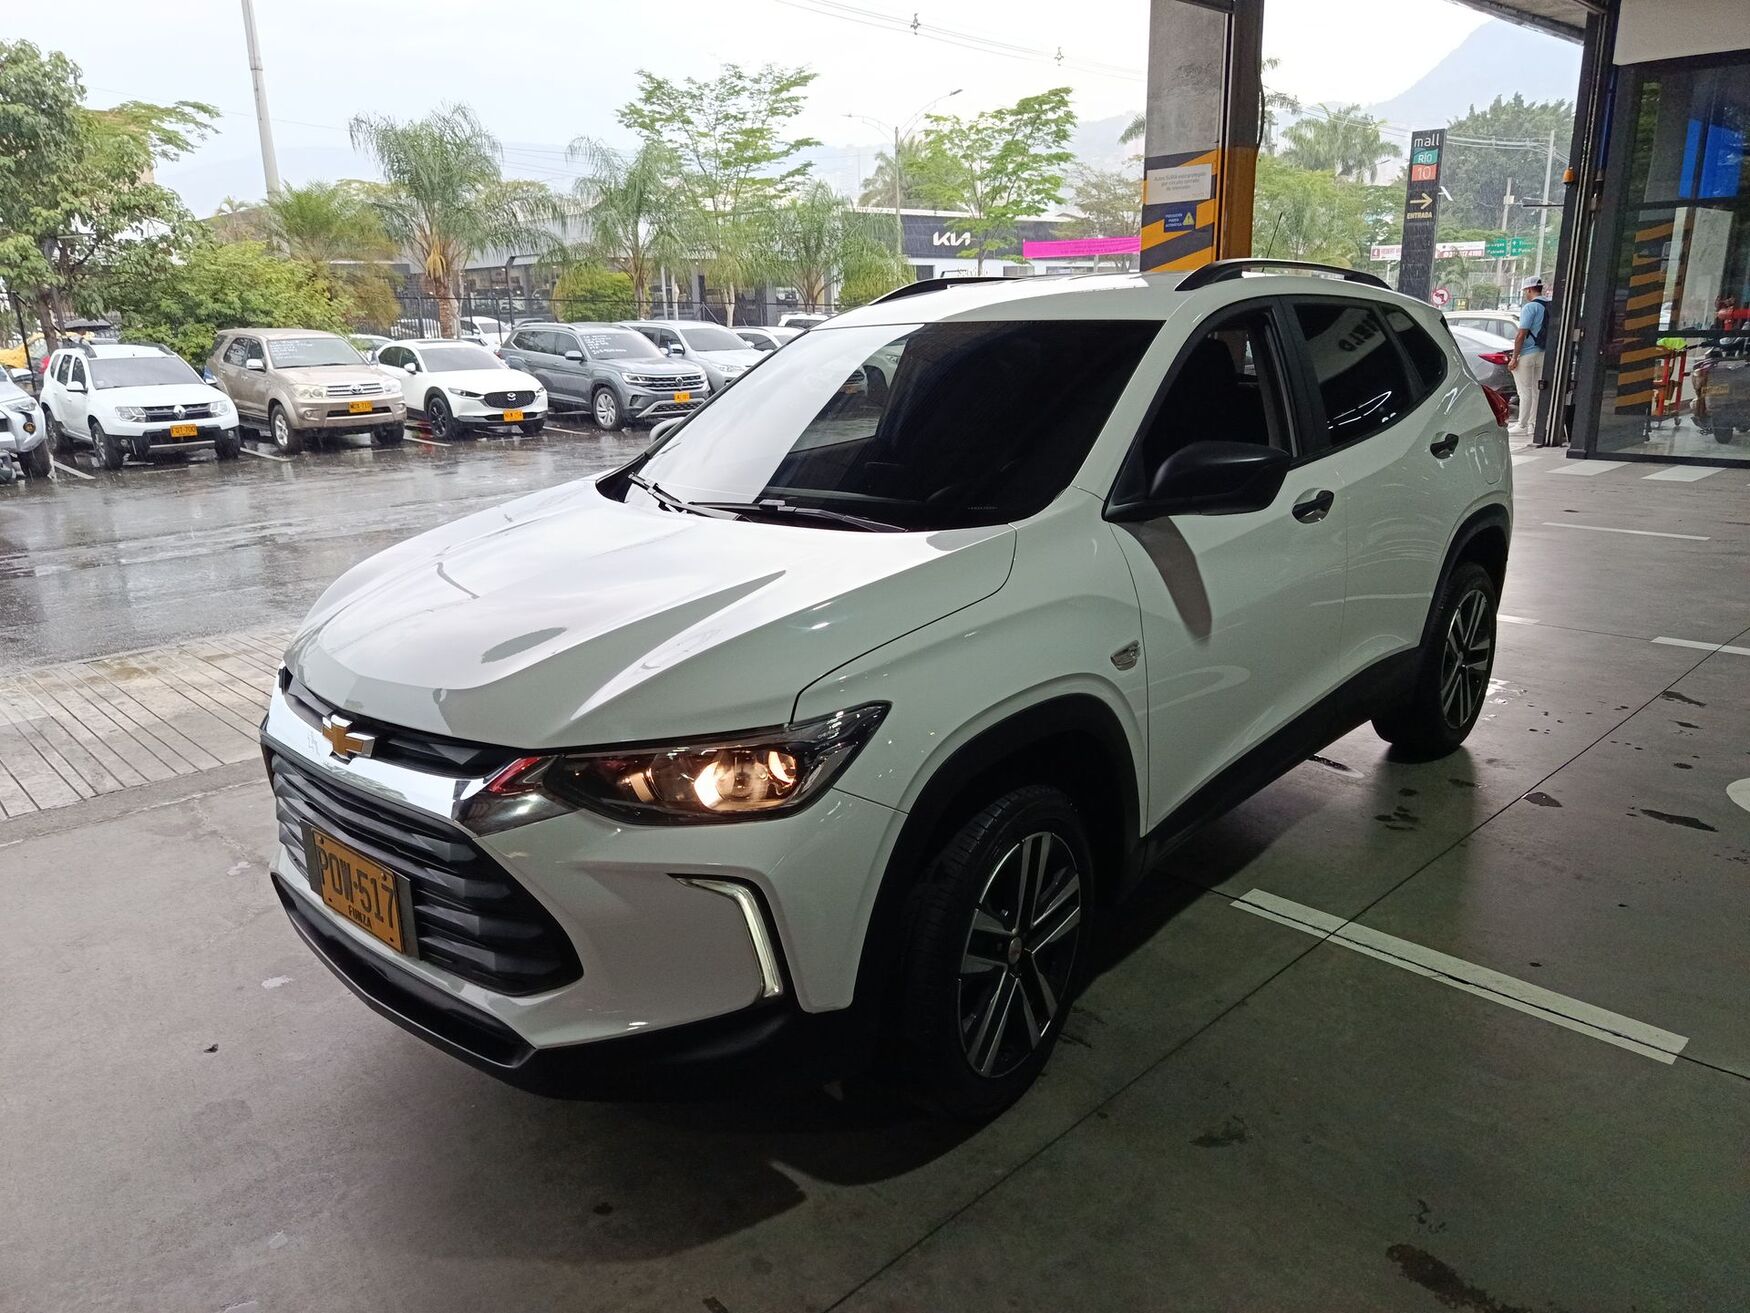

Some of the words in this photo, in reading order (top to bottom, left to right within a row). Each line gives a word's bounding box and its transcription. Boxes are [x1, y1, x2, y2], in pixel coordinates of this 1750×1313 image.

[1414, 133, 1440, 148] mall
[1418, 151, 1433, 163] RÍO
[1417, 166, 1432, 180] 10
[1406, 211, 1433, 220] ENTRADA
[932, 231, 971, 246] KIA
